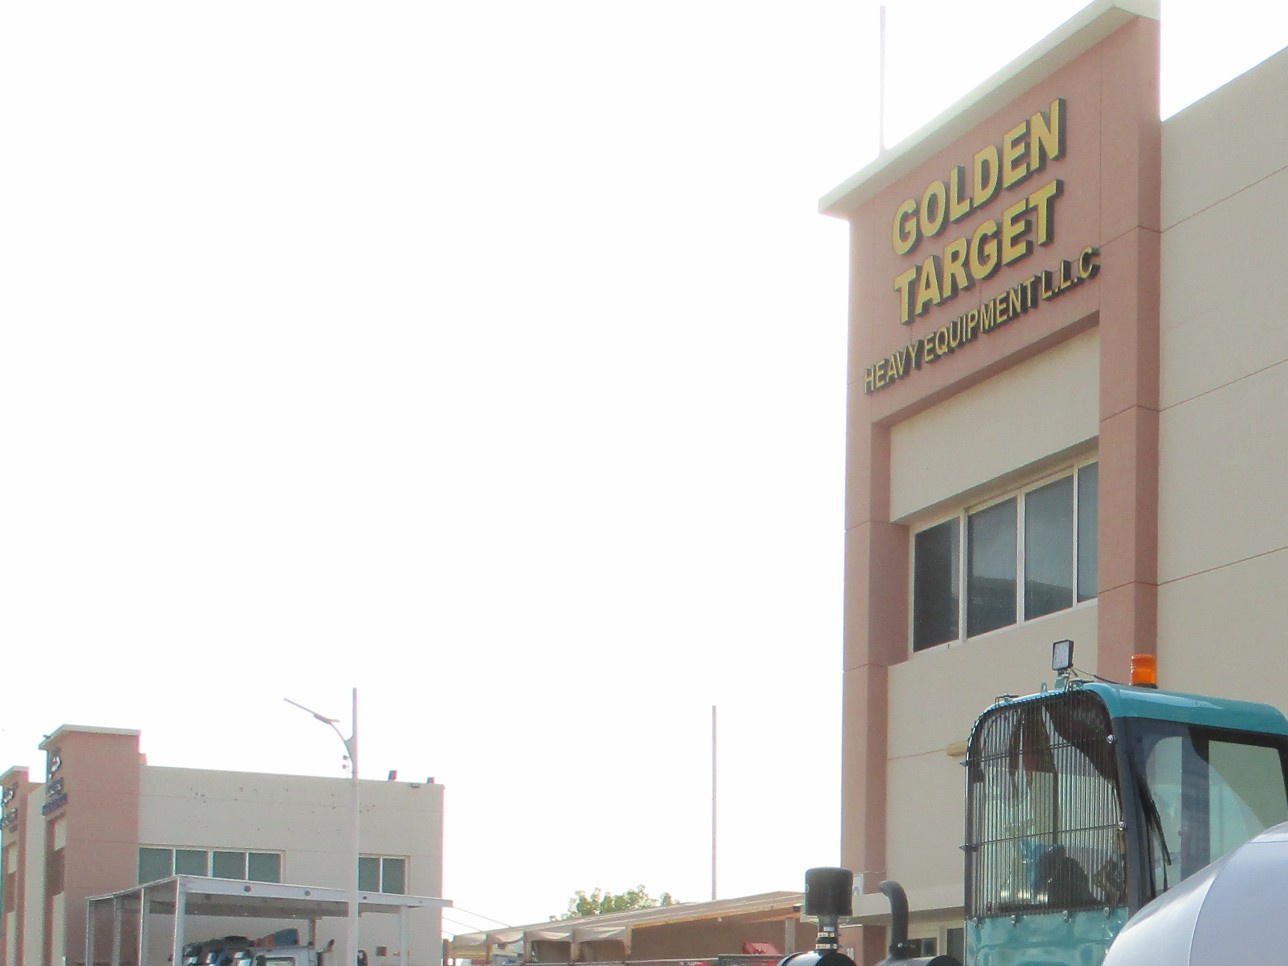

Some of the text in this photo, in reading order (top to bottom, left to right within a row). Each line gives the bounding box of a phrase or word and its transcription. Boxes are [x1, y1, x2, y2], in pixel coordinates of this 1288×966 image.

[892, 98, 1065, 255] GOLDEN
[864, 246, 1099, 395] HEAVY EQUIPMENT L.L.C
[893, 178, 1062, 325] TARGET
